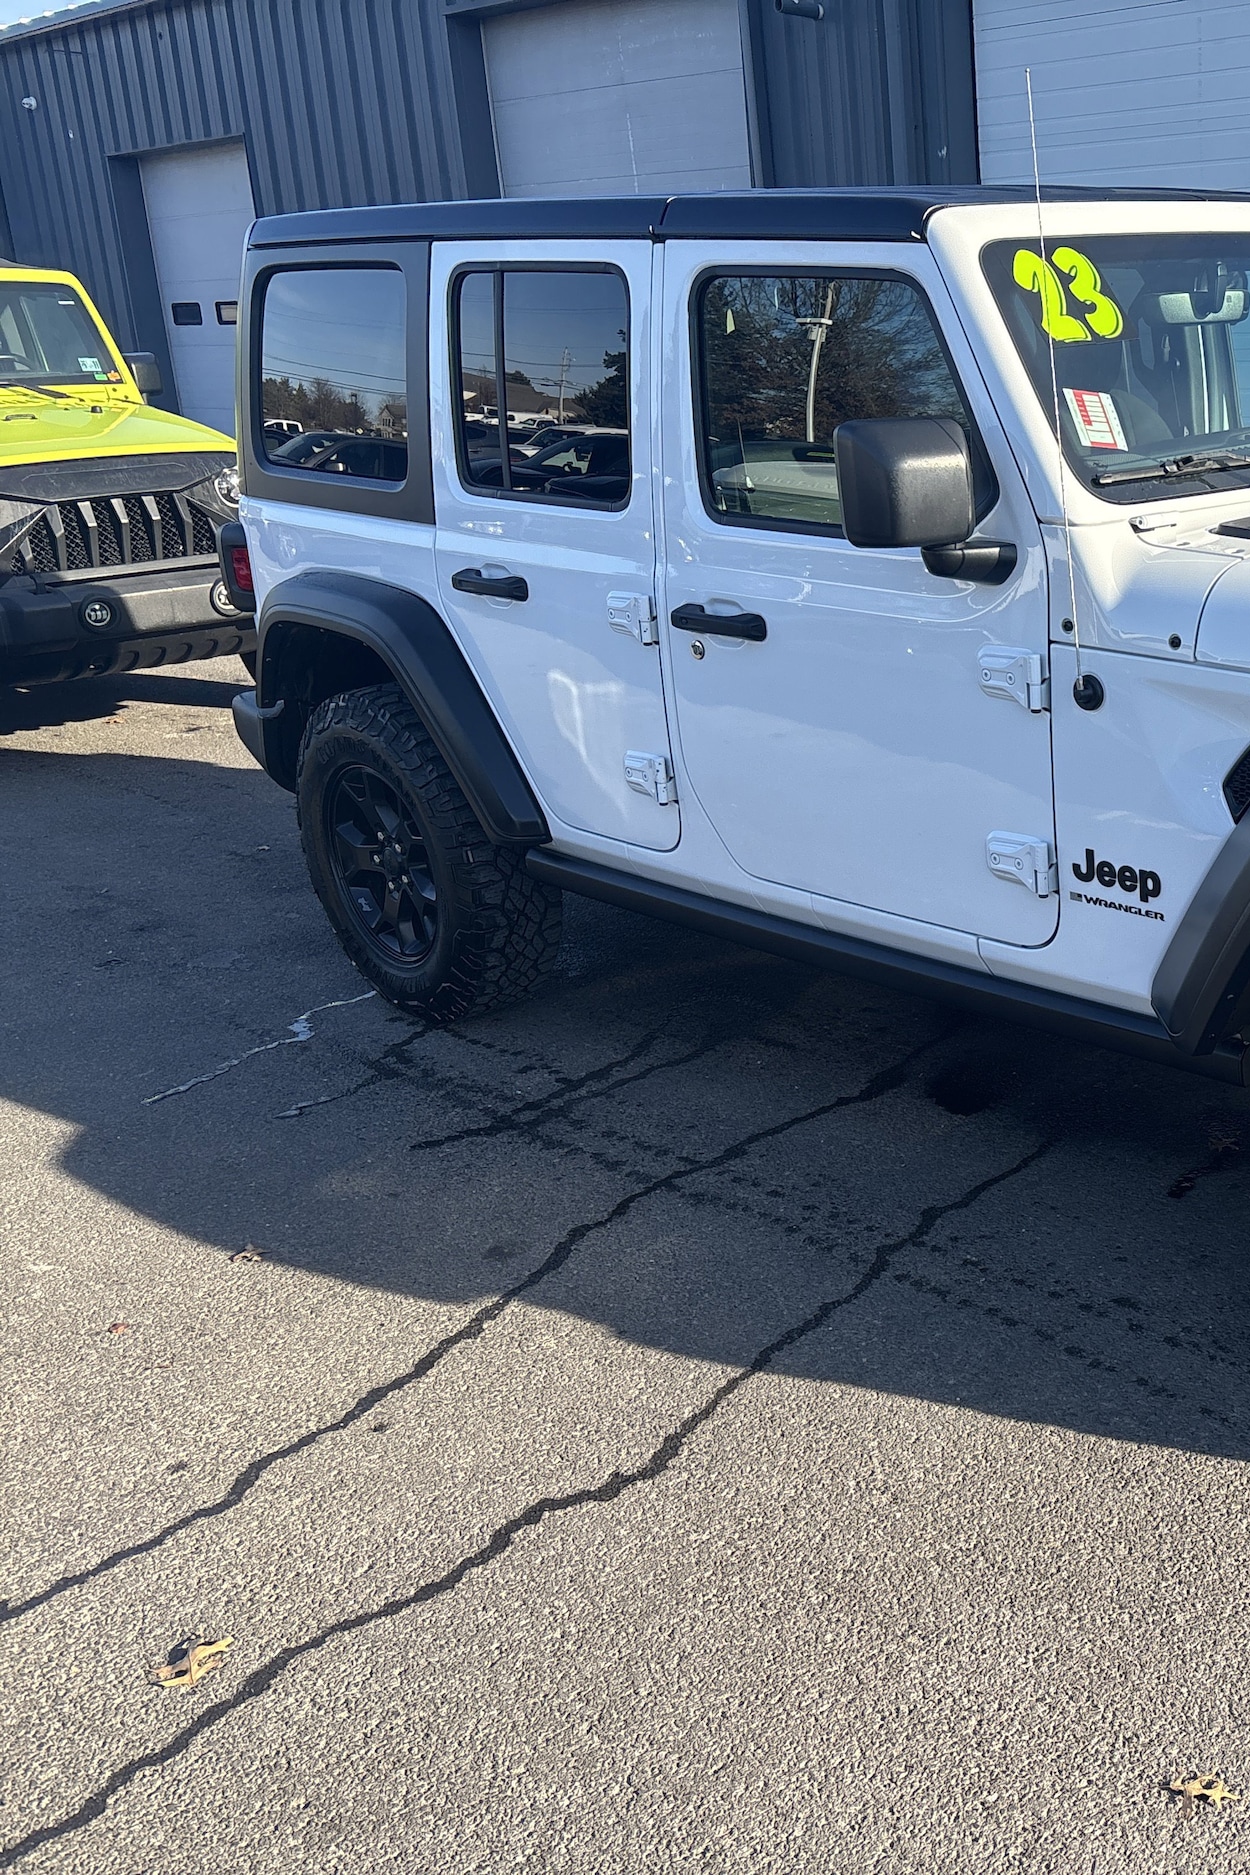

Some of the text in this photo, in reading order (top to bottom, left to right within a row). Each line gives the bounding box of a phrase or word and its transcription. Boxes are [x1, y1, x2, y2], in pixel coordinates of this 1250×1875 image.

[1012, 246, 1123, 343] 23
[1072, 848, 1162, 904] Jeep
[1083, 893, 1166, 922] WRANGLER
